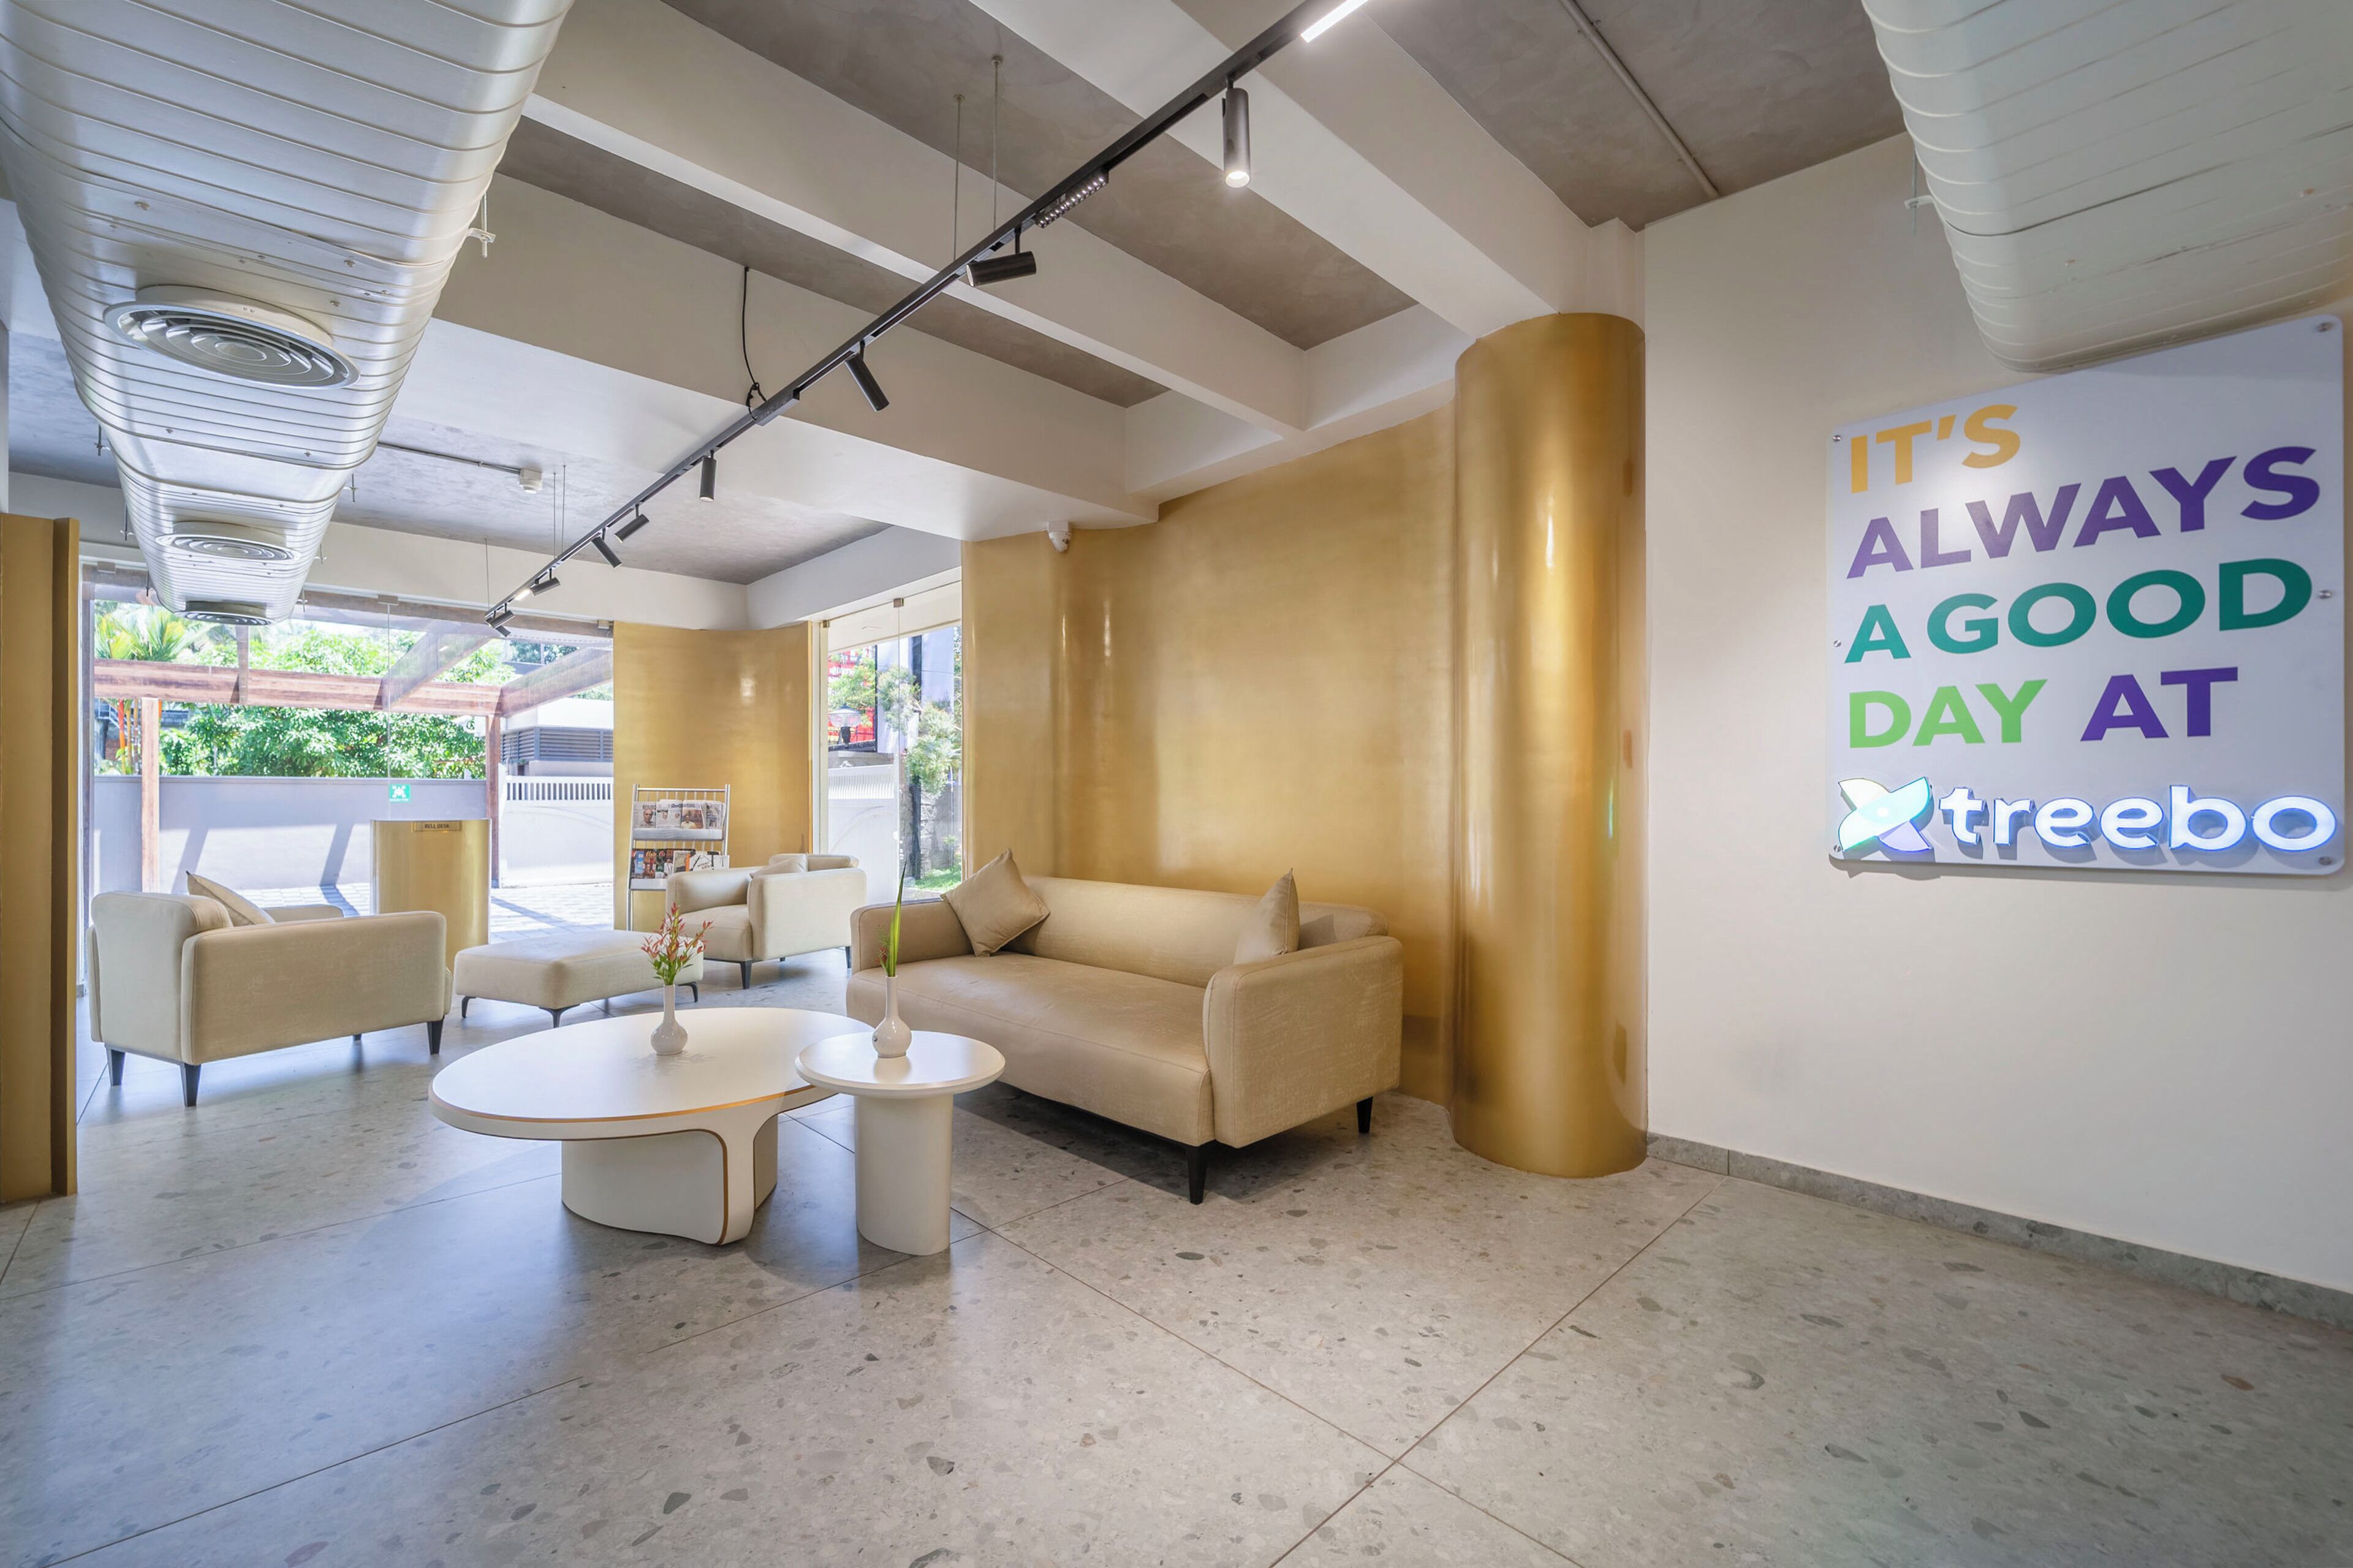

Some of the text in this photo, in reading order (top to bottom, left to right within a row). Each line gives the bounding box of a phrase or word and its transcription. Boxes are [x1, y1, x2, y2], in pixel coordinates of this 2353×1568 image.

[1851, 404, 2021, 493] IT'S
[1846, 446, 2321, 579] ALWAYS
[1844, 558, 2313, 664] A GOOD
[1849, 667, 2238, 748] DAY AT
[1939, 784, 2336, 851] treebo
